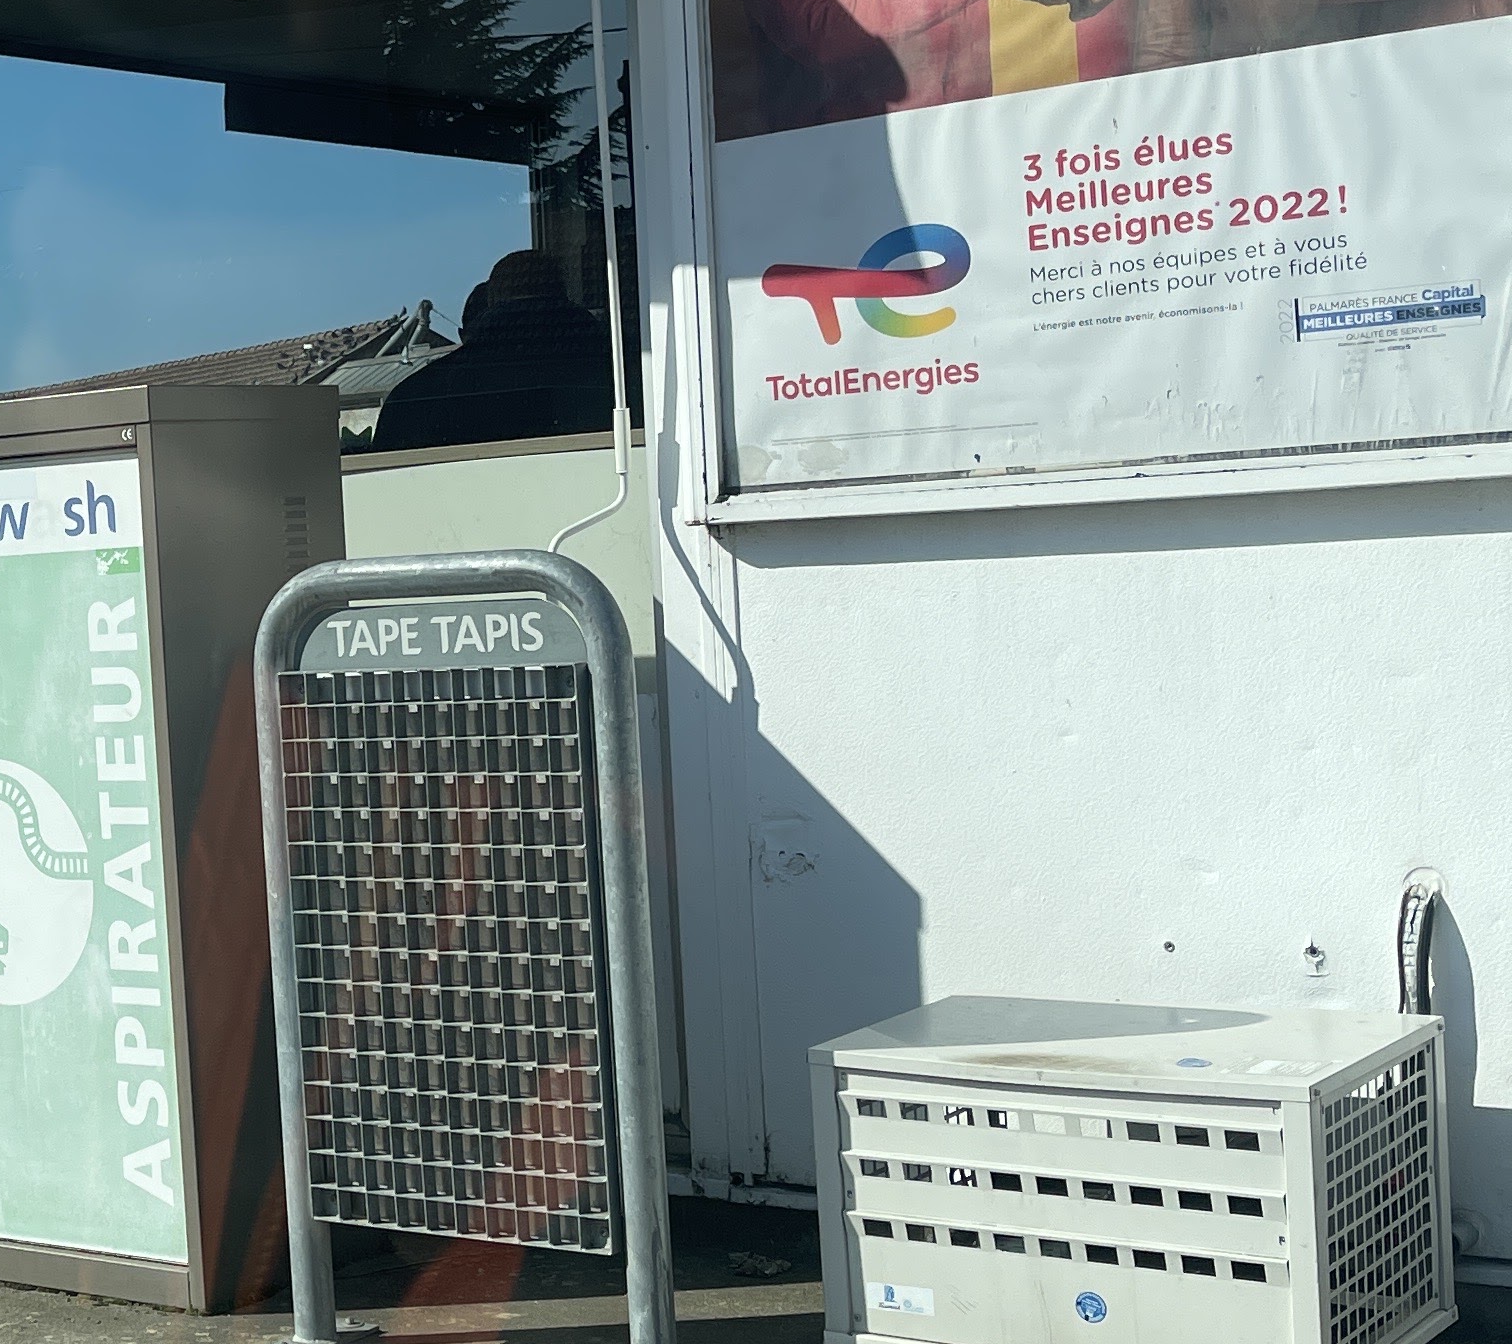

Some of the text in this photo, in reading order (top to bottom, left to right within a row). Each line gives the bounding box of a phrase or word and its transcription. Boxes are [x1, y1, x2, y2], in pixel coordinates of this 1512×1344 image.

[1023, 131, 1234, 182] 3 fois élues
[1025, 171, 1213, 217] Meilleures
[1030, 233, 1348, 283] Merci à nos équipes et à vous
[1031, 251, 1368, 305] chers clients pour votre fidélité
[1302, 309, 1394, 330] MEILLEURES
[1309, 284, 1474, 313] PALMARÈS FRANCE Capital
[1033, 318, 1076, 332] L'énergie
[1078, 318, 1093, 327] est
[1095, 315, 1122, 326] notre
[1278, 299, 1294, 344] 2022
[1346, 328, 1385, 341] QUALITÉ
[1386, 328, 1398, 337] DE
[1400, 324, 1438, 336] SERVICE
[765, 358, 980, 401] TotalEnergies
[326, 611, 544, 658] TAPE TAPIS
[86, 594, 176, 1207] ASPIRATEUR
